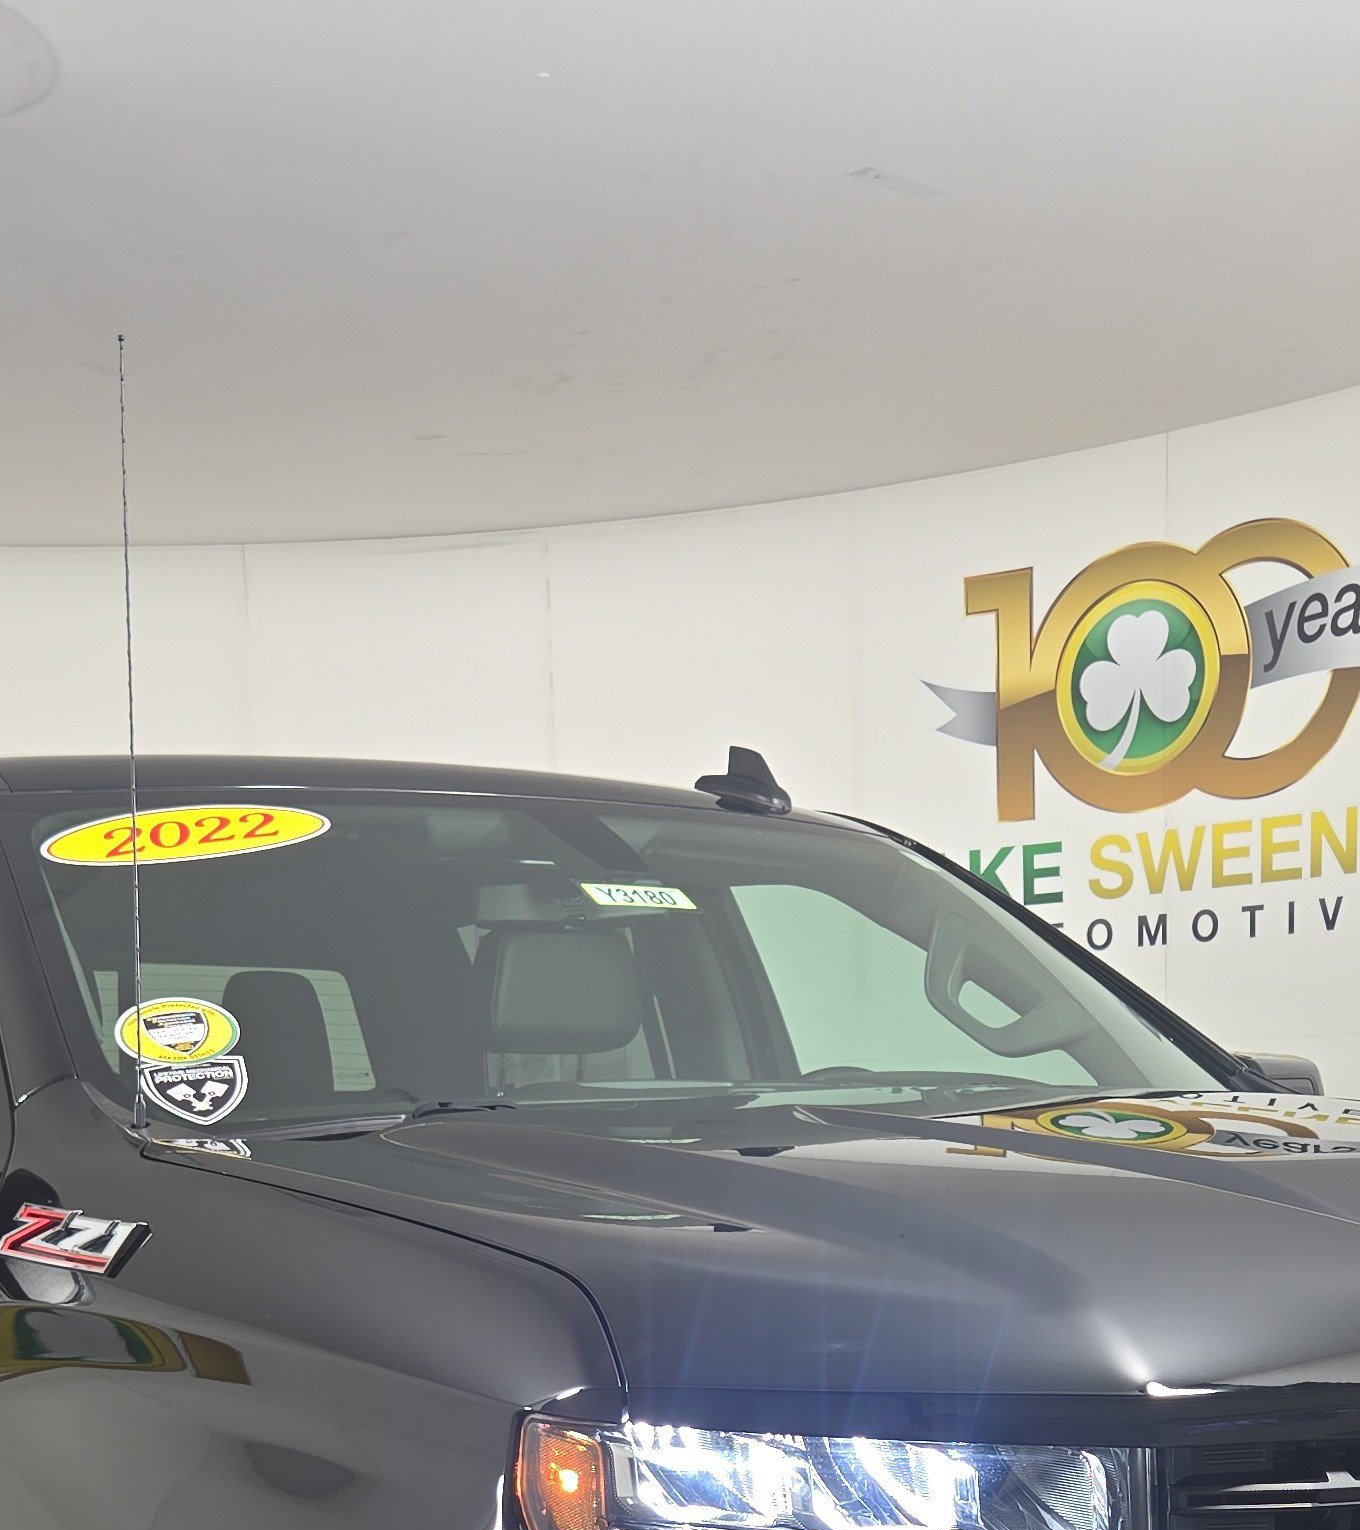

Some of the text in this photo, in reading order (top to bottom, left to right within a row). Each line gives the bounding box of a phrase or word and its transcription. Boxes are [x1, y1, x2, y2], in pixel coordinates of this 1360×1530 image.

[103, 812, 280, 858] 2022
[594, 886, 678, 906] Y3180
[942, 840, 1065, 906] KE
